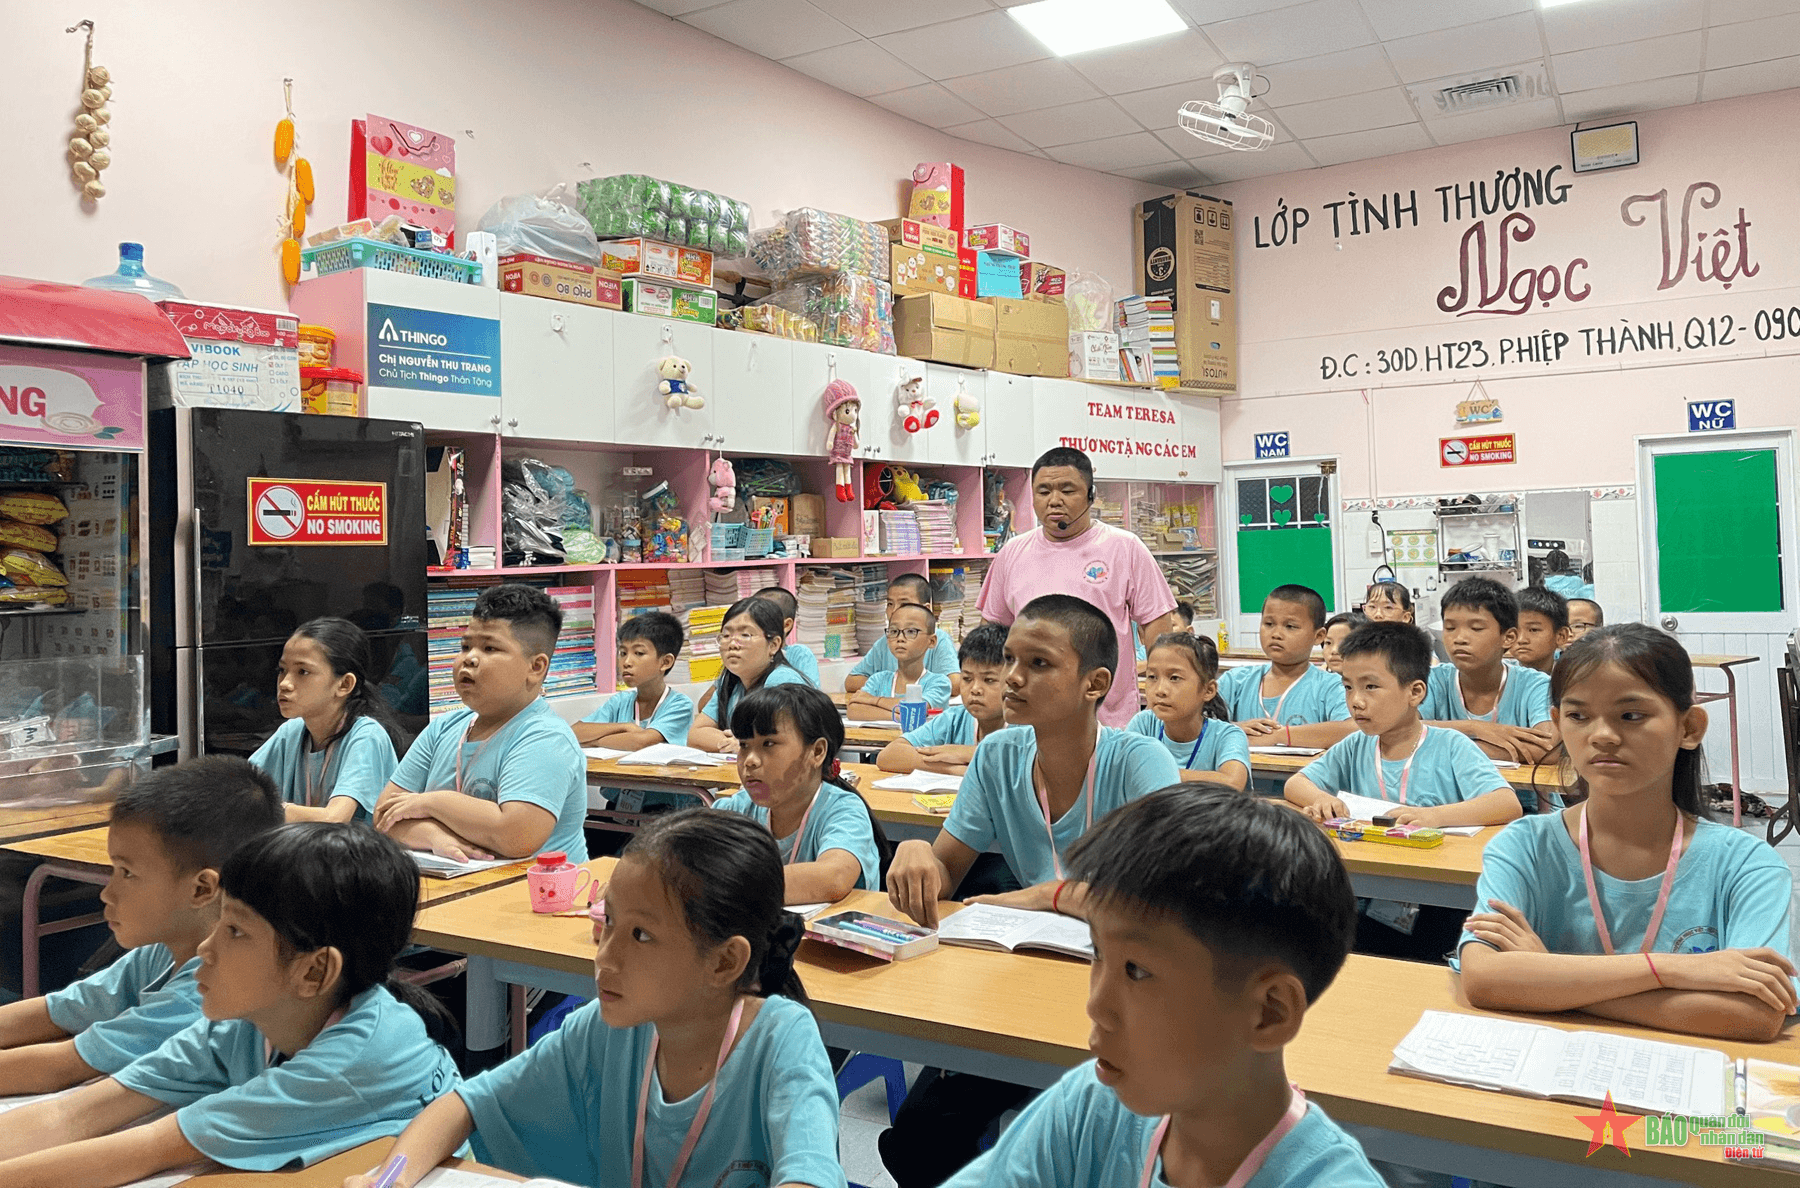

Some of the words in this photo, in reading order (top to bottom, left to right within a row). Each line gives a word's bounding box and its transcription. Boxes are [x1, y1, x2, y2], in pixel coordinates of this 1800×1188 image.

[1254, 197, 1309, 248] LỚP
[1323, 191, 1417, 238] TÌNH
[1435, 165, 1573, 223] THƯƠNG
[1437, 212, 1591, 317] Ngọc
[1620, 181, 1760, 290] Việt
[599, 280, 619, 290] VIFON
[399, 330, 447, 347] THINGO
[191, 343, 241, 357] VIBOOK
[232, 361, 259, 373] SINH
[379, 353, 396, 367] Chị
[399, 355, 438, 369] NGUYỄN
[441, 359, 459, 370] THU
[461, 362, 491, 373] TRANG
[379, 368, 398, 378] Chủ
[400, 370, 417, 381] Tịch
[419, 371, 448, 384] Thingo
[451, 374, 471, 384] Thân
[1088, 402, 1122, 418] TEAM
[1126, 406, 1176, 424] TERESA
[1470, 405, 1489, 414] WC
[1691, 402, 1732, 418] WC
[1699, 418, 1725, 430] NỮ
[1154, 438, 1179, 458] CÁC
[1181, 444, 1196, 458] EM
[1257, 433, 1288, 448] WC
[1481, 439, 1493, 450] HÚT
[1260, 448, 1286, 458] NAM
[1470, 453, 1480, 462] NO
[1481, 451, 1512, 461] SMOKING
[306, 489, 327, 511] CẤM
[329, 492, 349, 512] HÚT
[350, 490, 380, 512] THUỐC
[307, 519, 325, 535] NO
[327, 518, 381, 535] SMOKING
